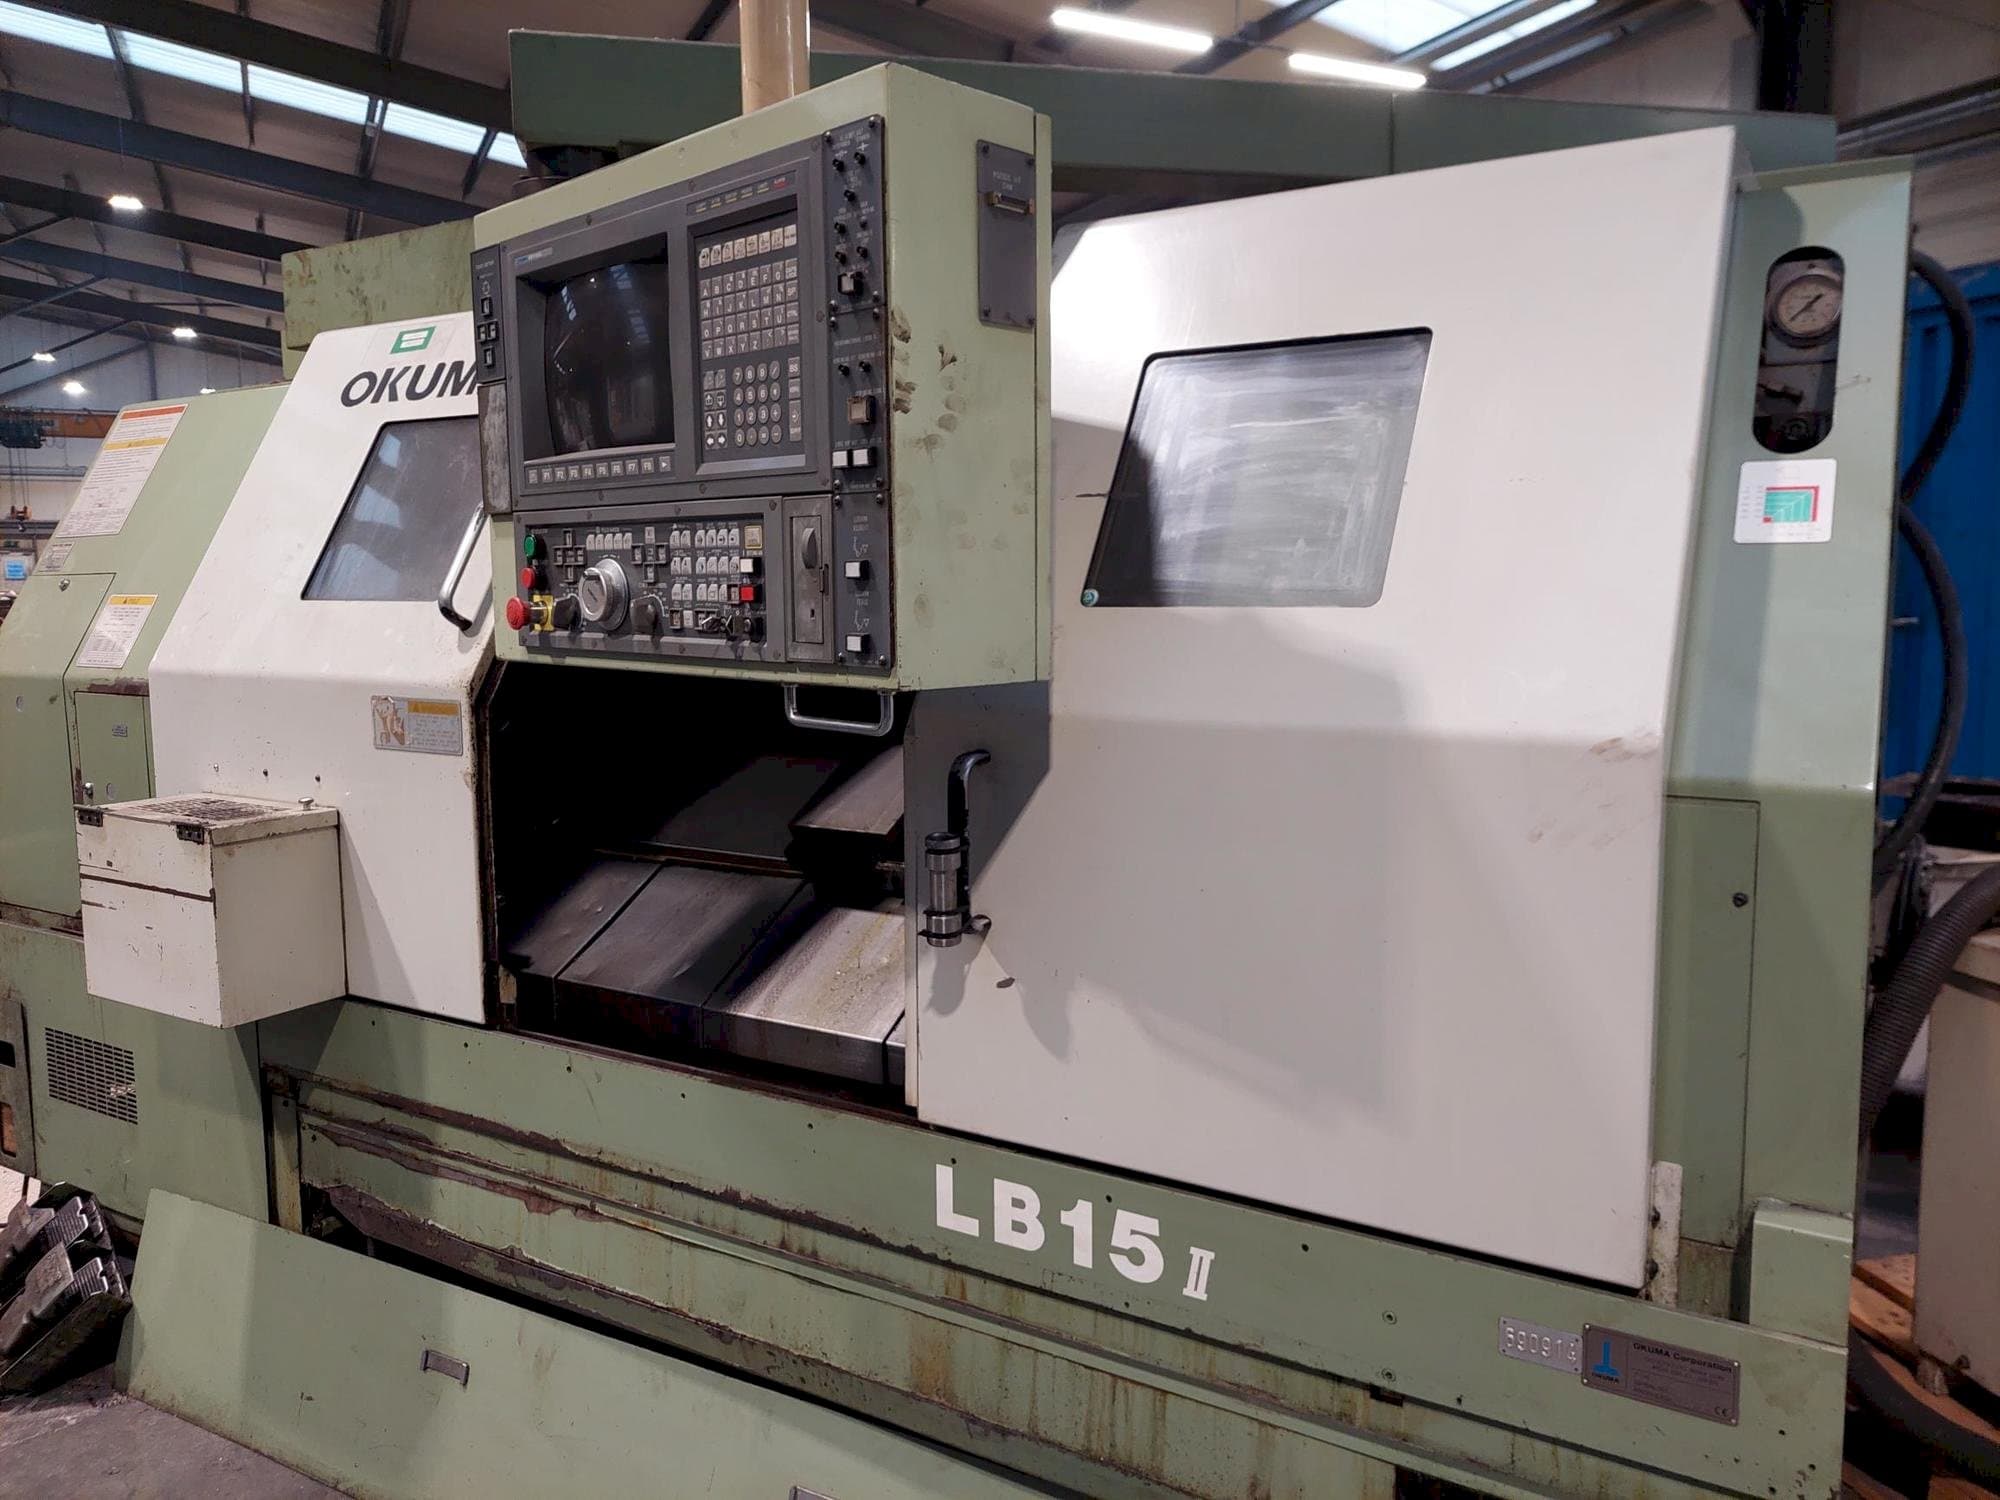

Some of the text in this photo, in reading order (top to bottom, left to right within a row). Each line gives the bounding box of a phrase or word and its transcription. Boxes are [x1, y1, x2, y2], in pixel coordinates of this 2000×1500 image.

[628, 463, 636, 471] F7
[644, 462, 651, 470] F8
[936, 1163, 1215, 1301] LB15 II
[1633, 1342, 1732, 1373] OKUMA Corporation
